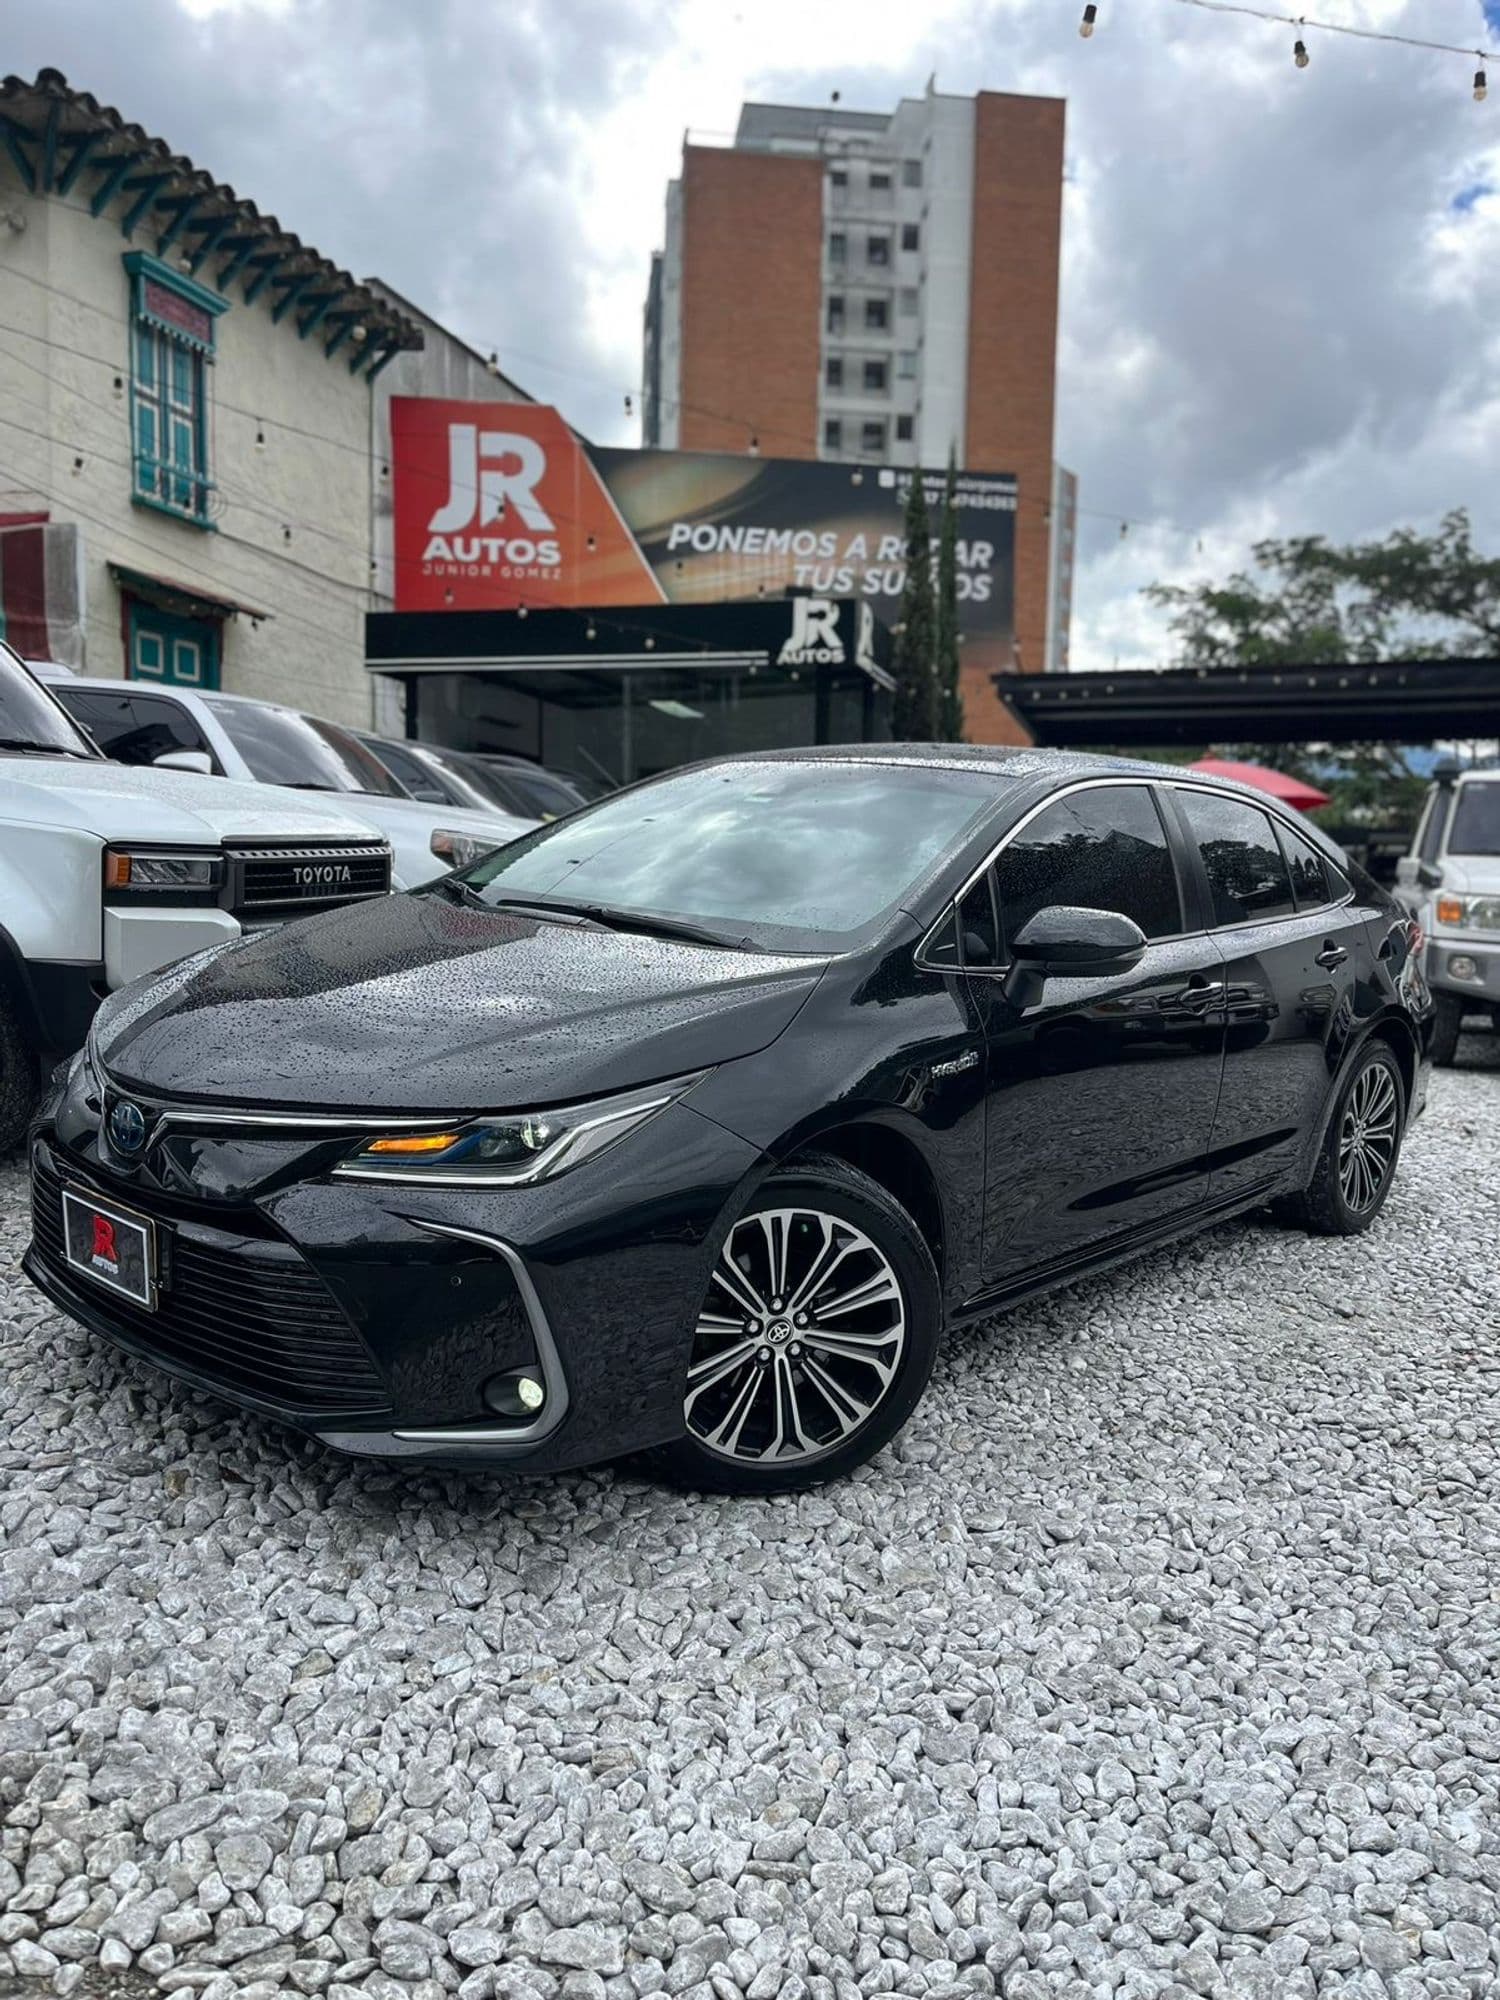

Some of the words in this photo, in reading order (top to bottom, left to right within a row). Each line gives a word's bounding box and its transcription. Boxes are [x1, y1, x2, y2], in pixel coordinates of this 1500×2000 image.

[428, 423, 556, 533] JR
[422, 535, 562, 566] AUTOS
[667, 523, 837, 558] PONEMOS
[844, 533, 867, 561] A
[422, 562, 492, 576] JUNIOR
[501, 566, 562, 581] GOMEZ
[793, 564, 854, 592] TUS
[781, 597, 843, 650] JR
[776, 648, 846, 666] AUTOS
[293, 864, 352, 884] TOYOTA
